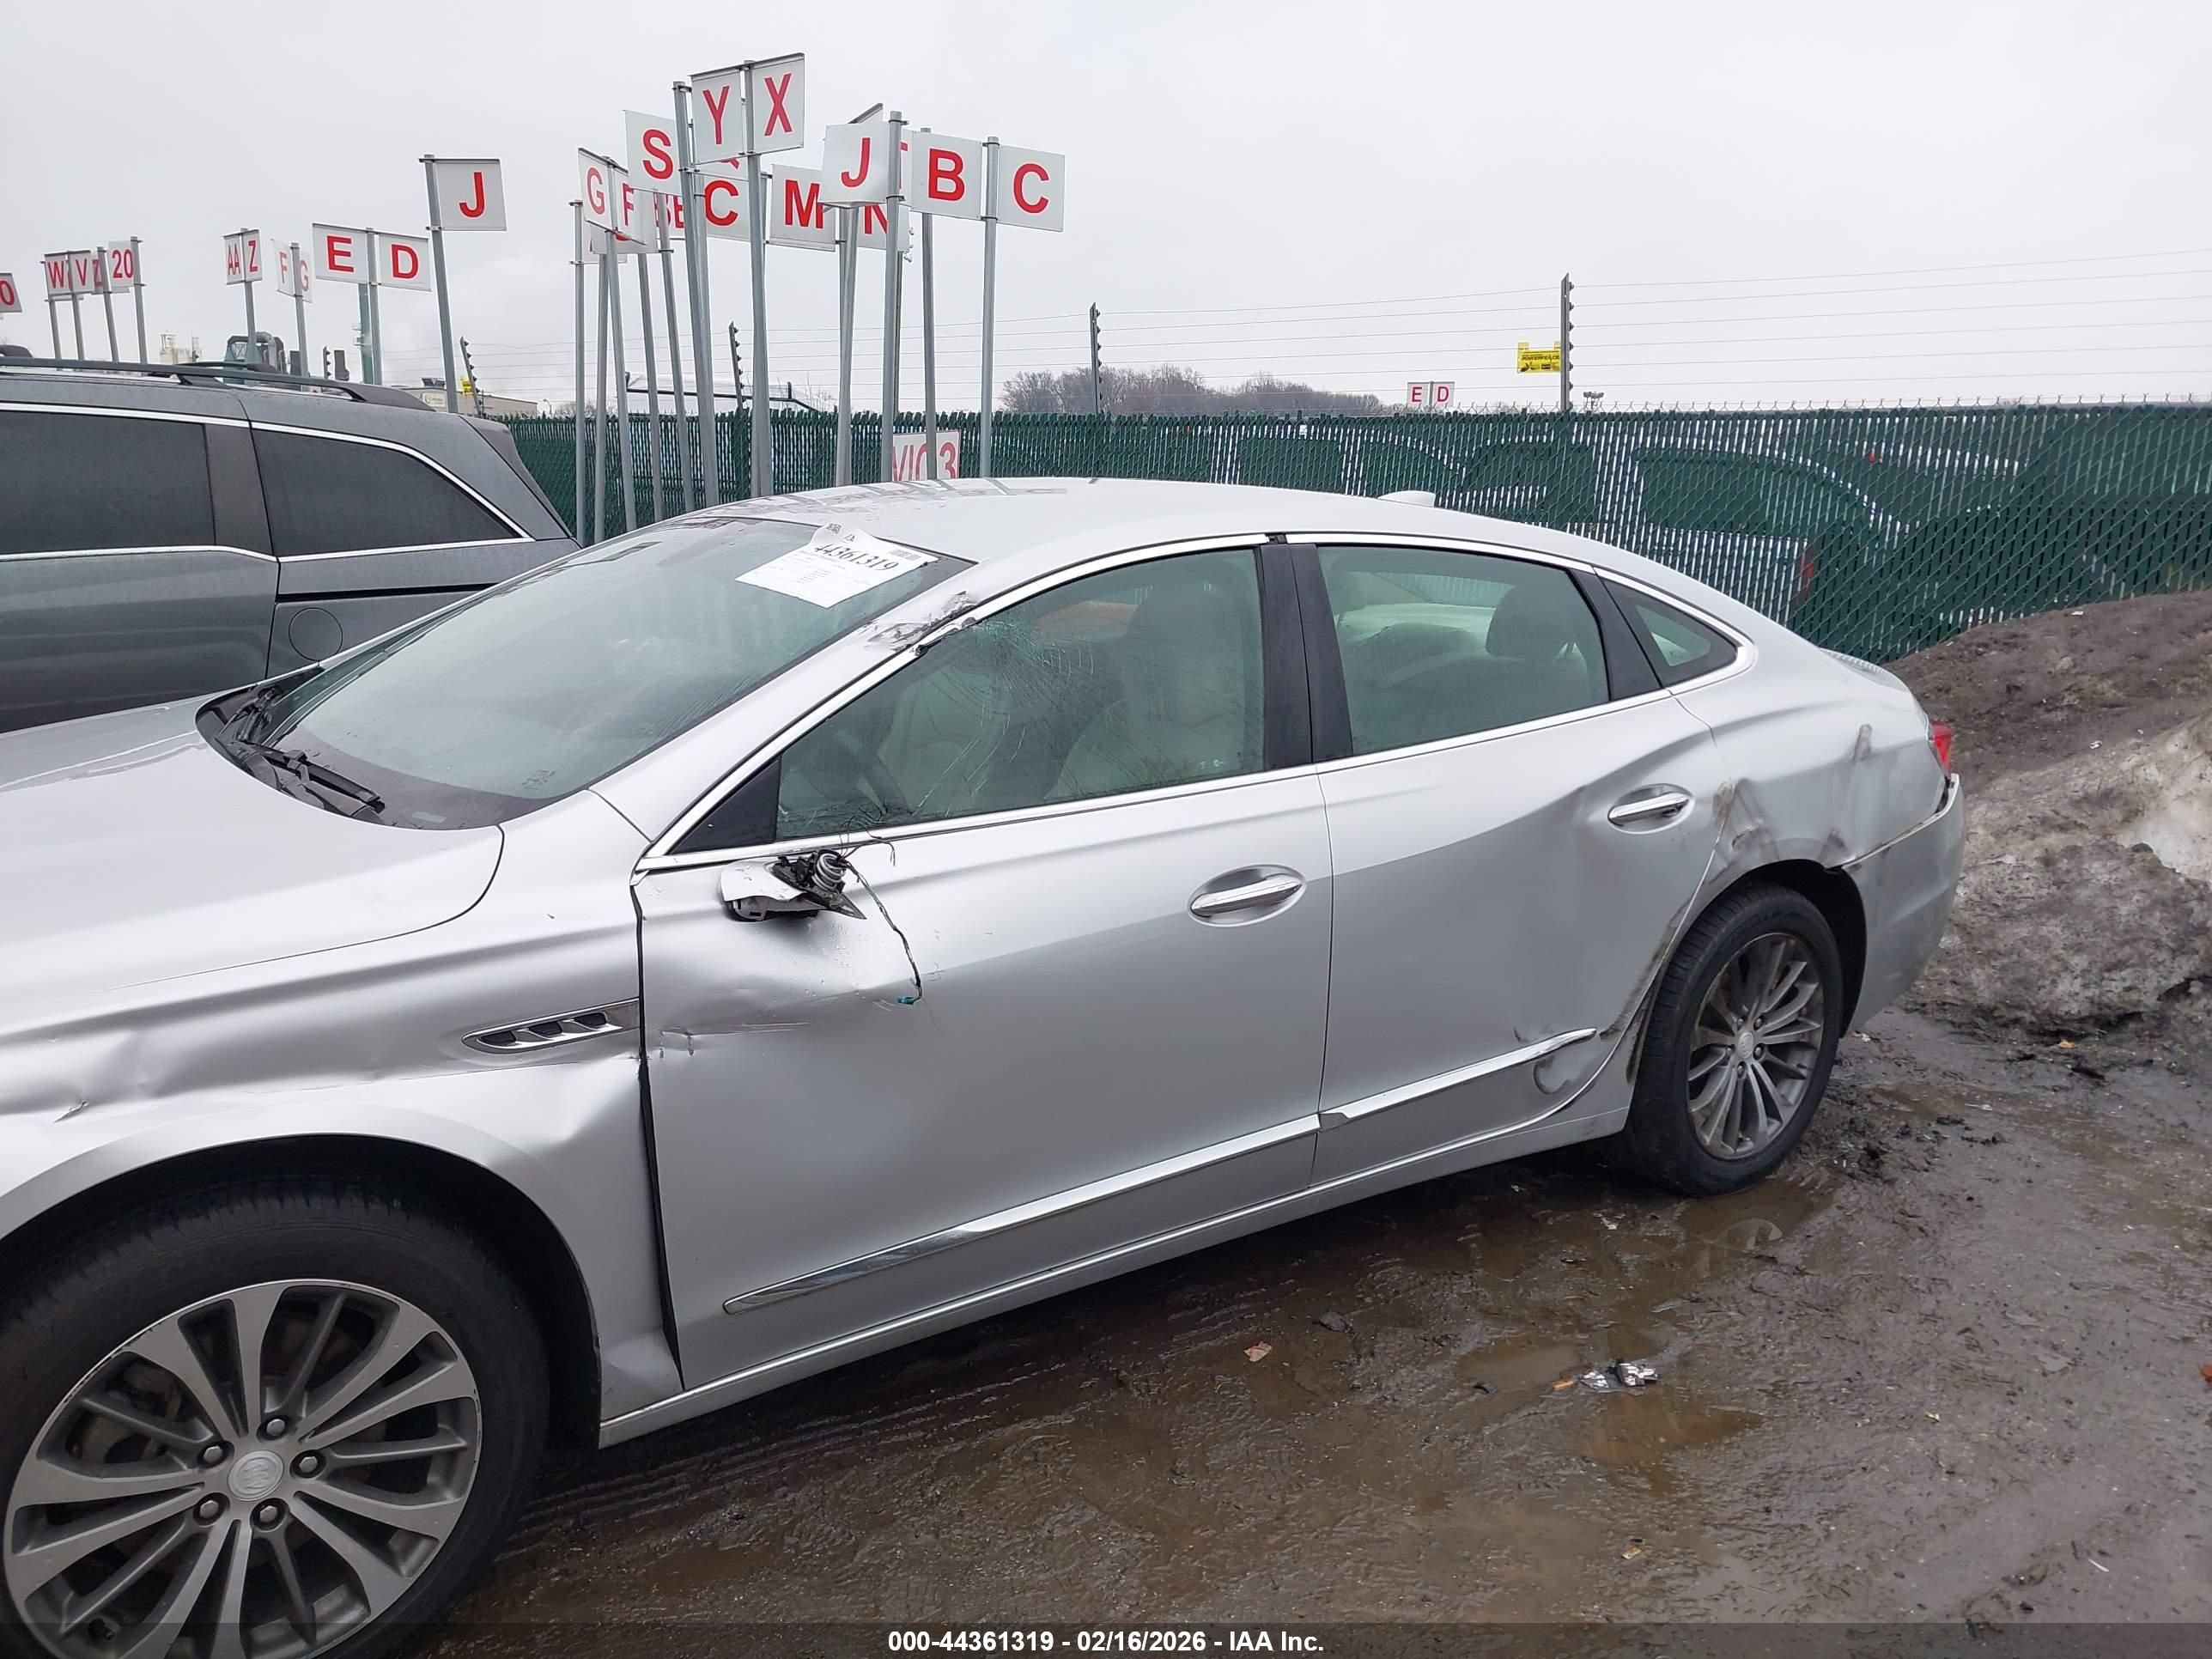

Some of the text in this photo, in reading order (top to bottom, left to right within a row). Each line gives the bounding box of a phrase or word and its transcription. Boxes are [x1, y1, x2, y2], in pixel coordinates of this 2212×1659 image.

[702, 73, 792, 144] Y X
[642, 129, 674, 179] S
[841, 137, 871, 187] J
[459, 172, 485, 217] J
[586, 167, 635, 226] G F
[704, 180, 739, 226] C
[928, 148, 1049, 213] B C
[784, 179, 824, 229] M
[48, 261, 64, 289] W
[76, 258, 88, 286] V
[112, 249, 134, 279] 20
[228, 240, 258, 276] AA Z
[279, 252, 288, 283] F
[326, 235, 419, 279] E D
[1411, 386, 1449, 402] E D
[814, 544, 899, 571] 44361319
